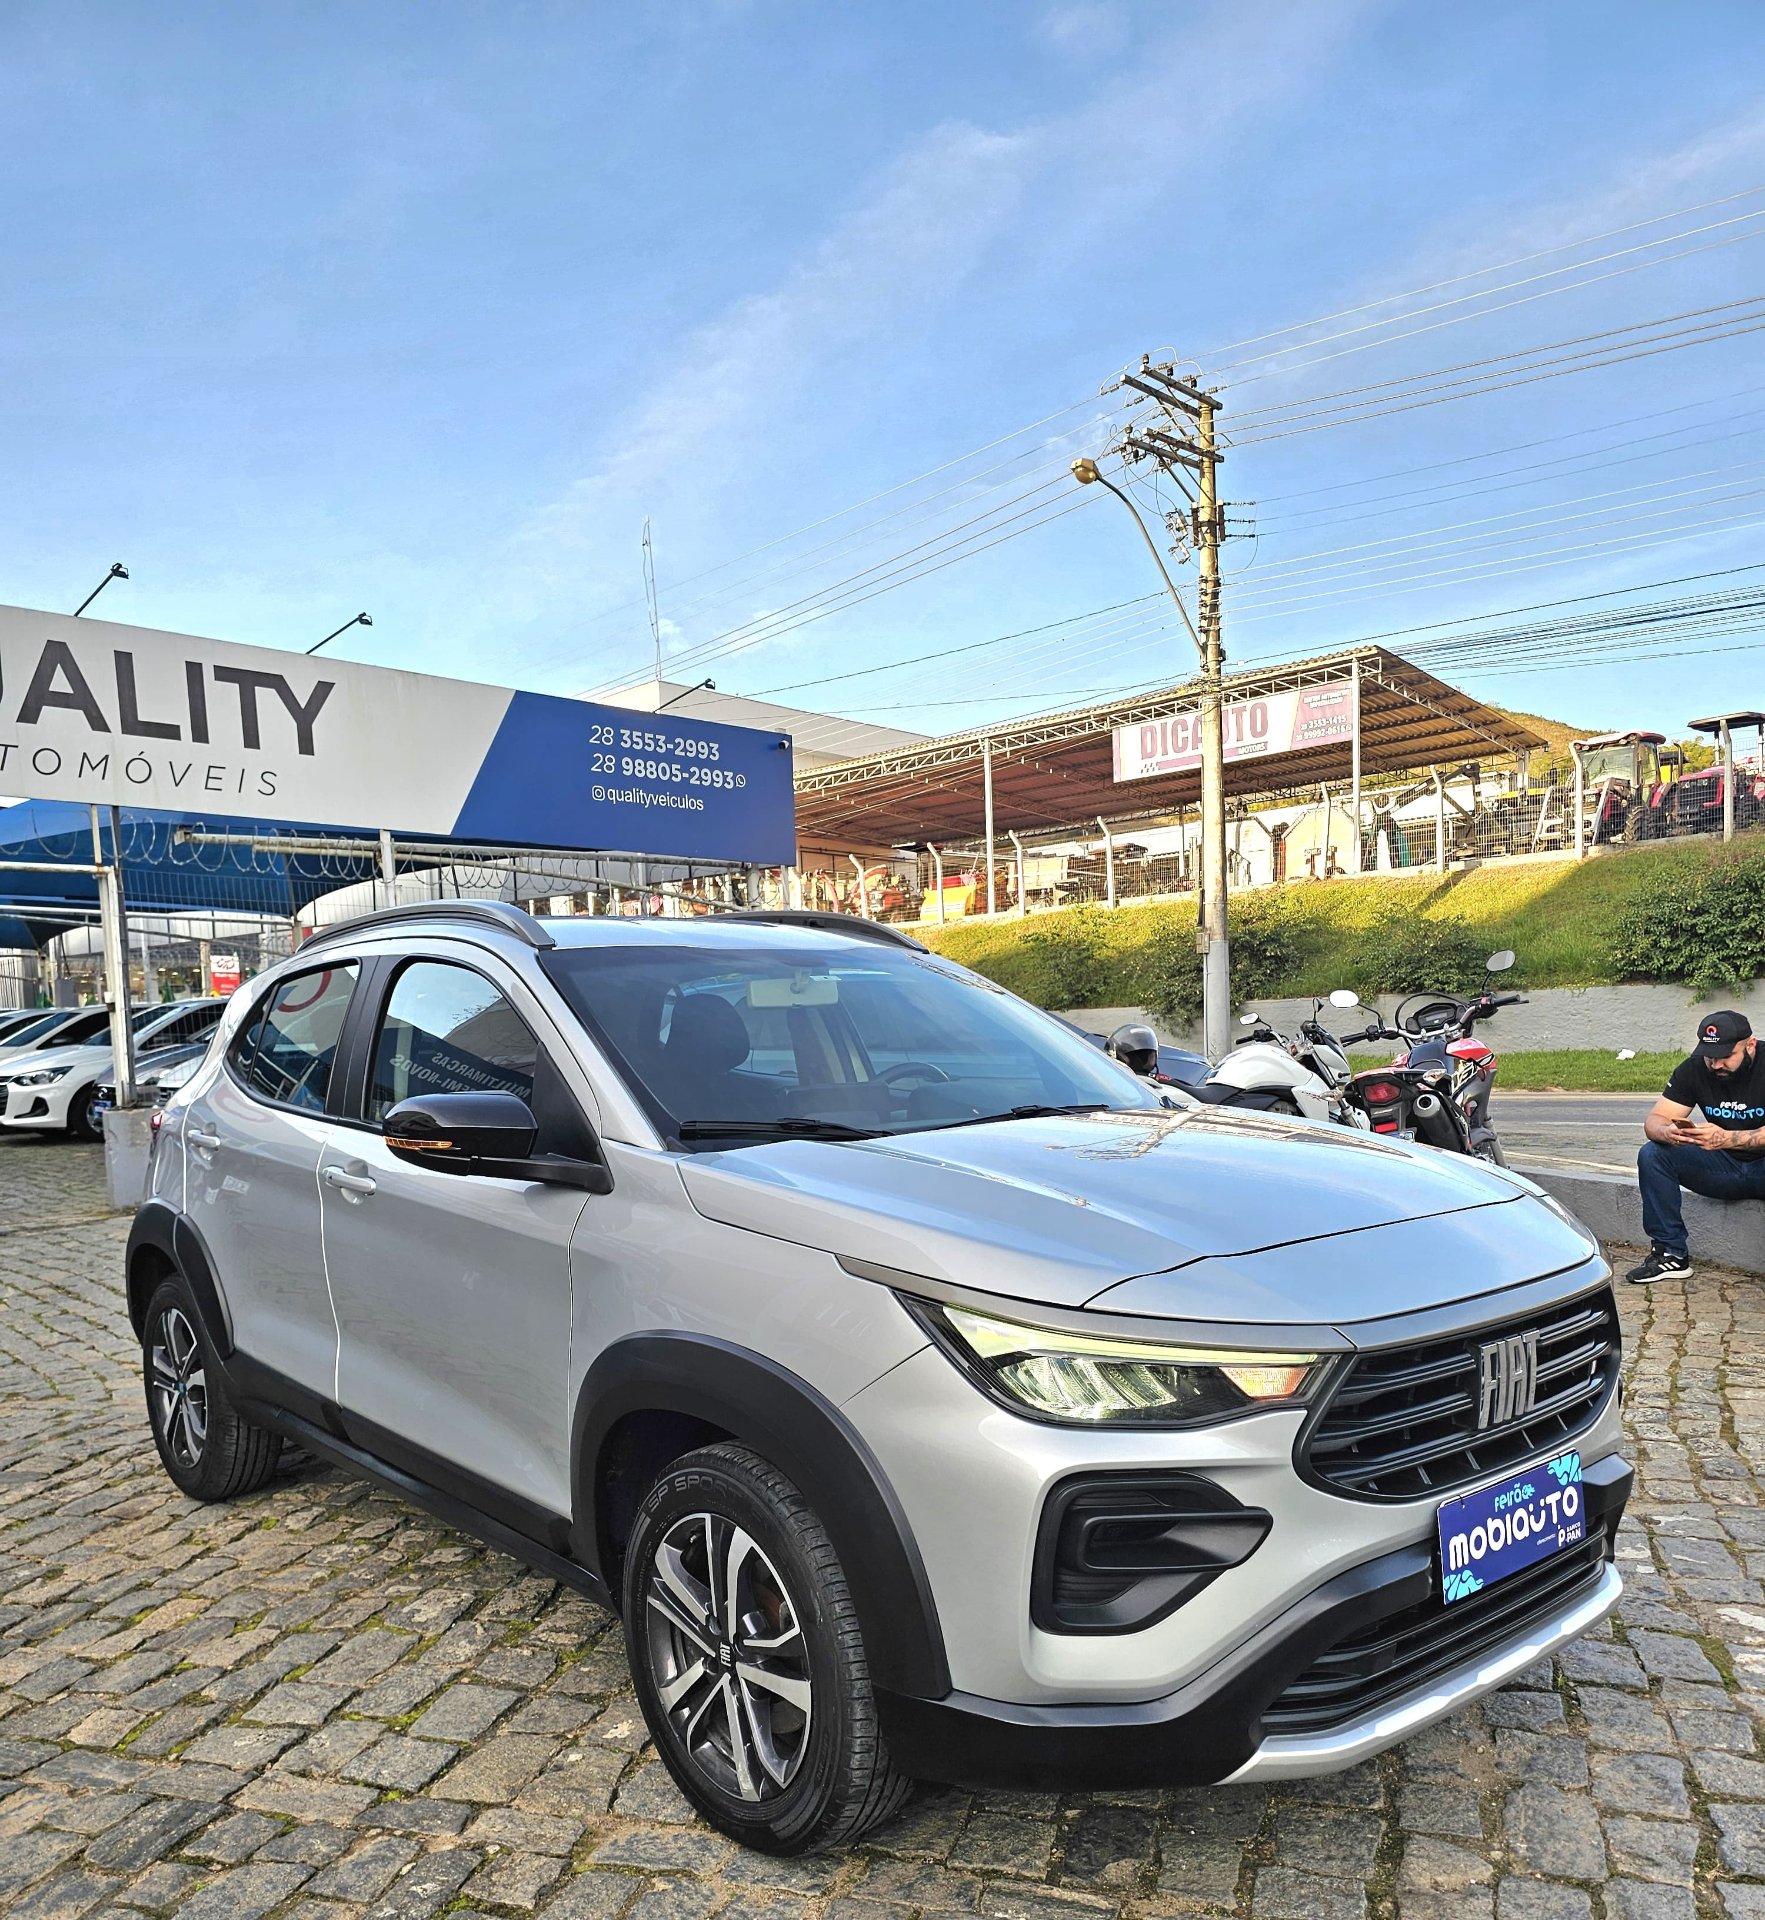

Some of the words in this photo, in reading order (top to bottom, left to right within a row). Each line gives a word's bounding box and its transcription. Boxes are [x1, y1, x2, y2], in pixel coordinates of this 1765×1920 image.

[0, 639, 336, 756] ALITY
[588, 725, 614, 746] 28
[620, 729, 720, 761] 3553-2993
[1238, 742, 1266, 755] MOTORS
[590, 753, 616, 774] 28
[621, 757, 734, 789] 98805-2993
[607, 787, 704, 811] qualityveiculos
[1478, 1327, 1541, 1430] FIAT
[648, 1484, 669, 1513] SP
[1566, 1527, 1581, 1543] PAN
[720, 1641, 731, 1667] FIAT
